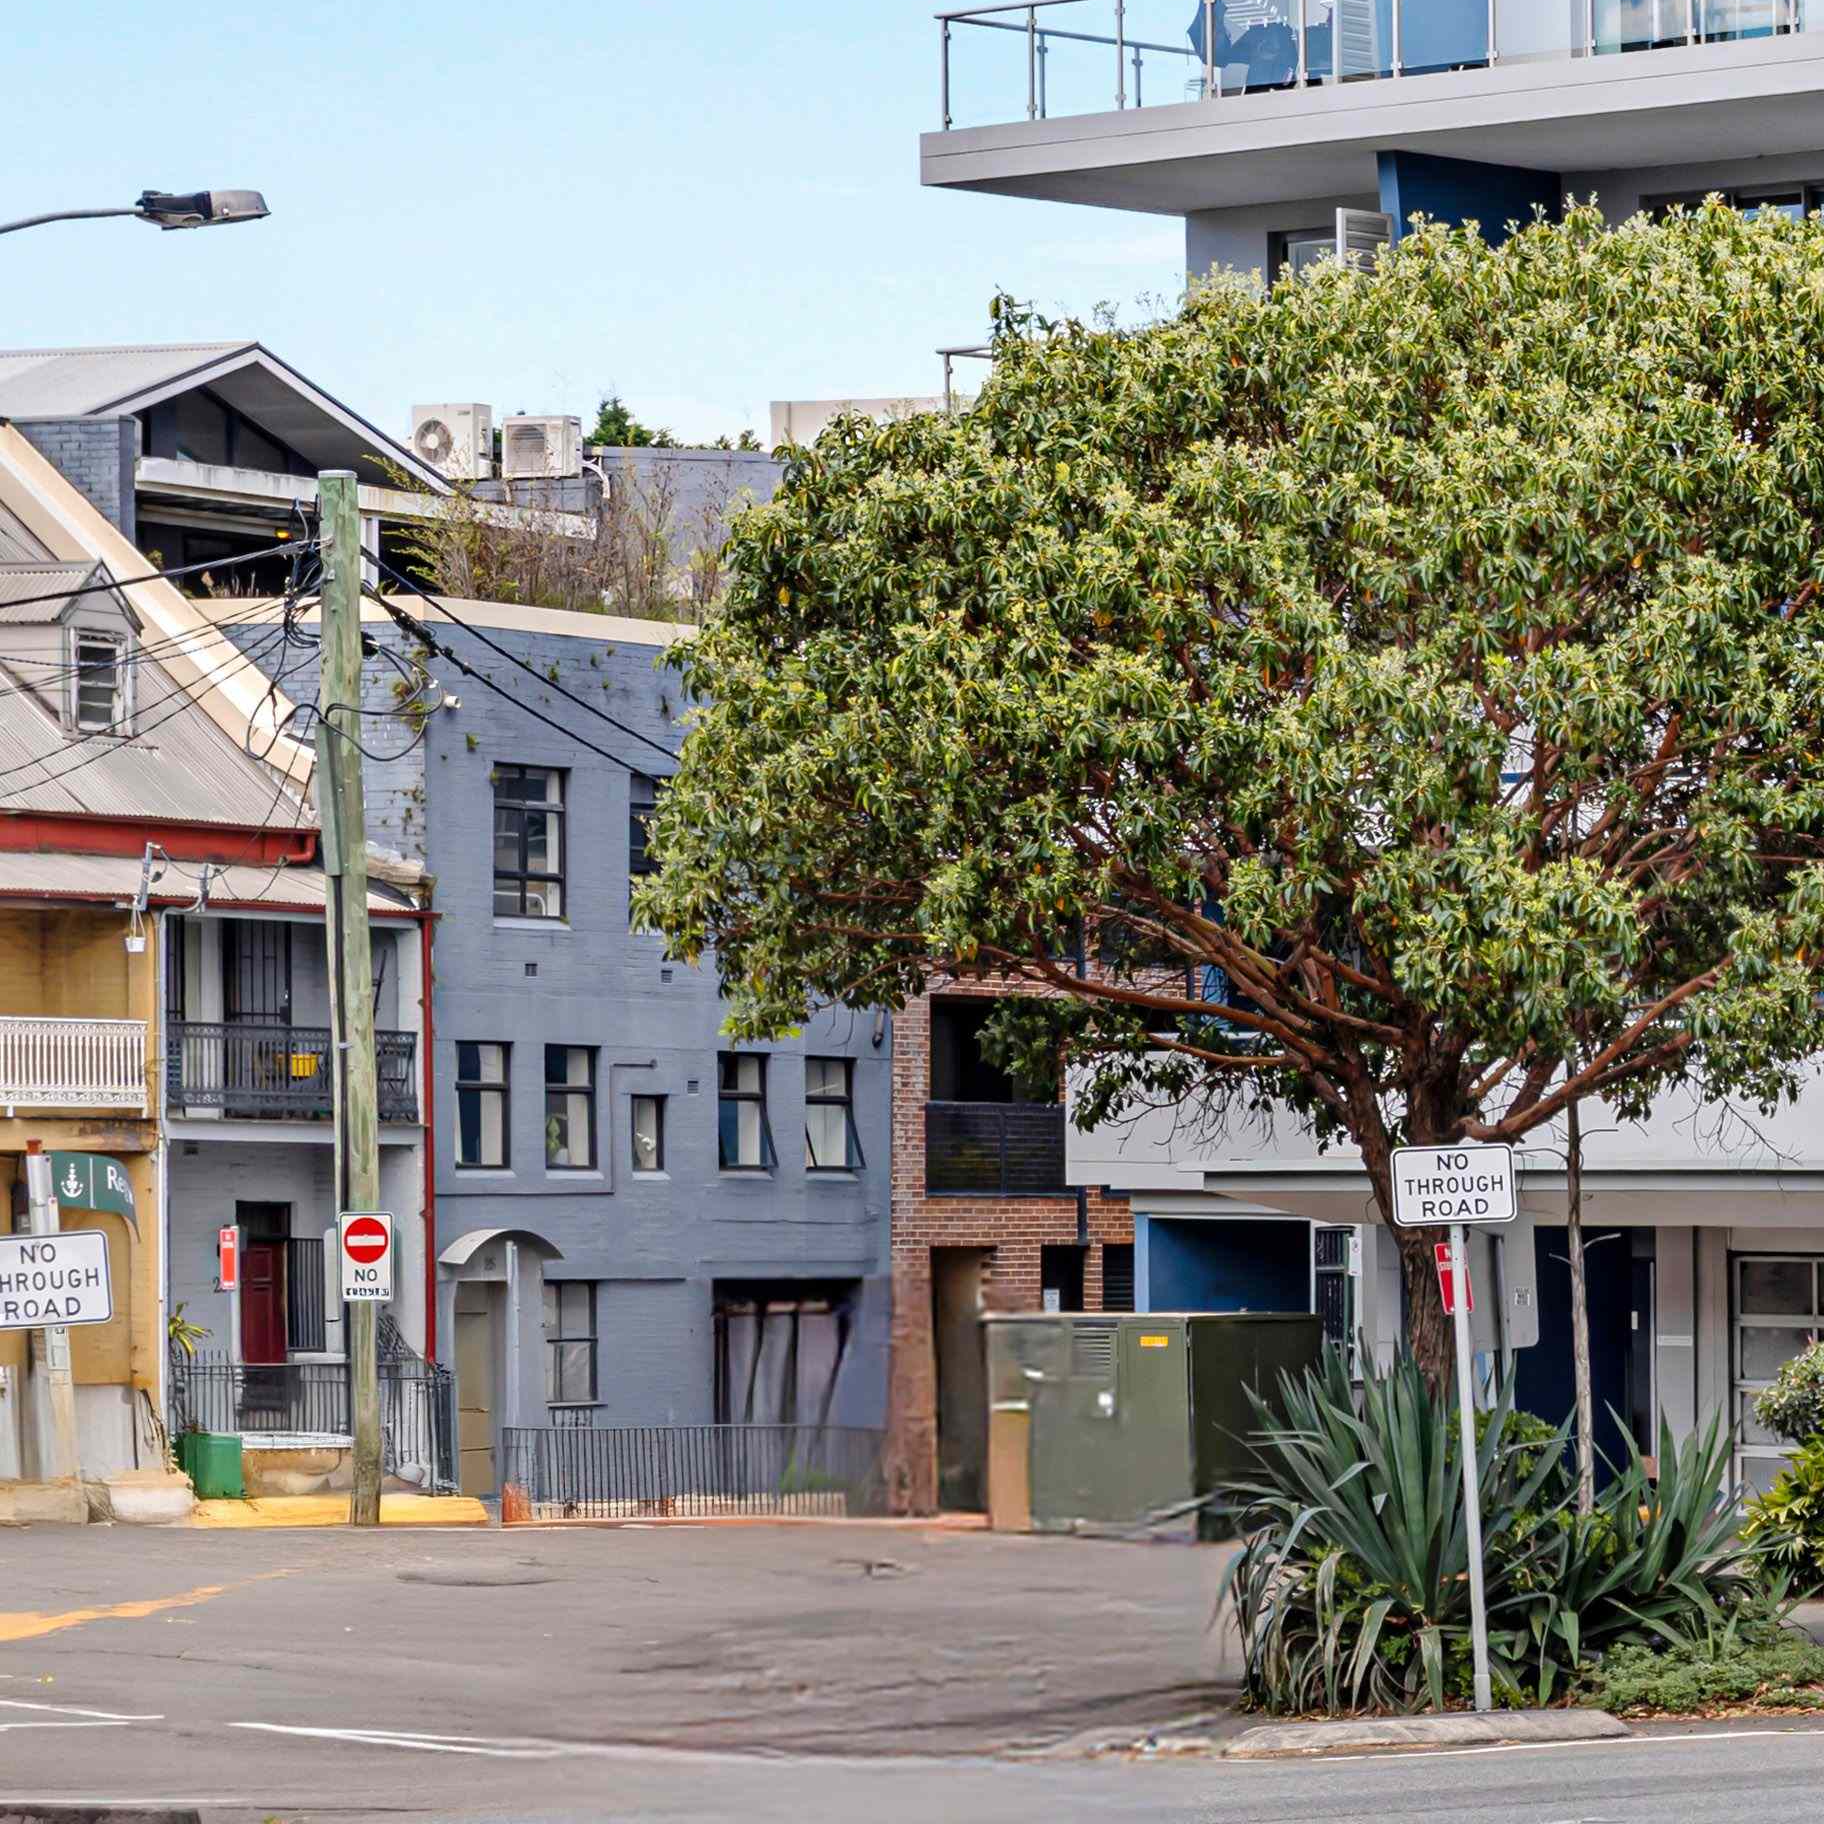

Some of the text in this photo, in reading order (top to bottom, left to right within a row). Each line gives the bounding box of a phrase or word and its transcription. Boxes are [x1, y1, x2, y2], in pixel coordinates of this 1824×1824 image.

[1436, 1153, 1469, 1171] NO
[1404, 1175, 1504, 1196] THROUGH
[1422, 1198, 1489, 1217] ROAD
[20, 1243, 56, 1265] NO
[354, 1268, 378, 1282] NO
[4, 1297, 82, 1321] ROAD
